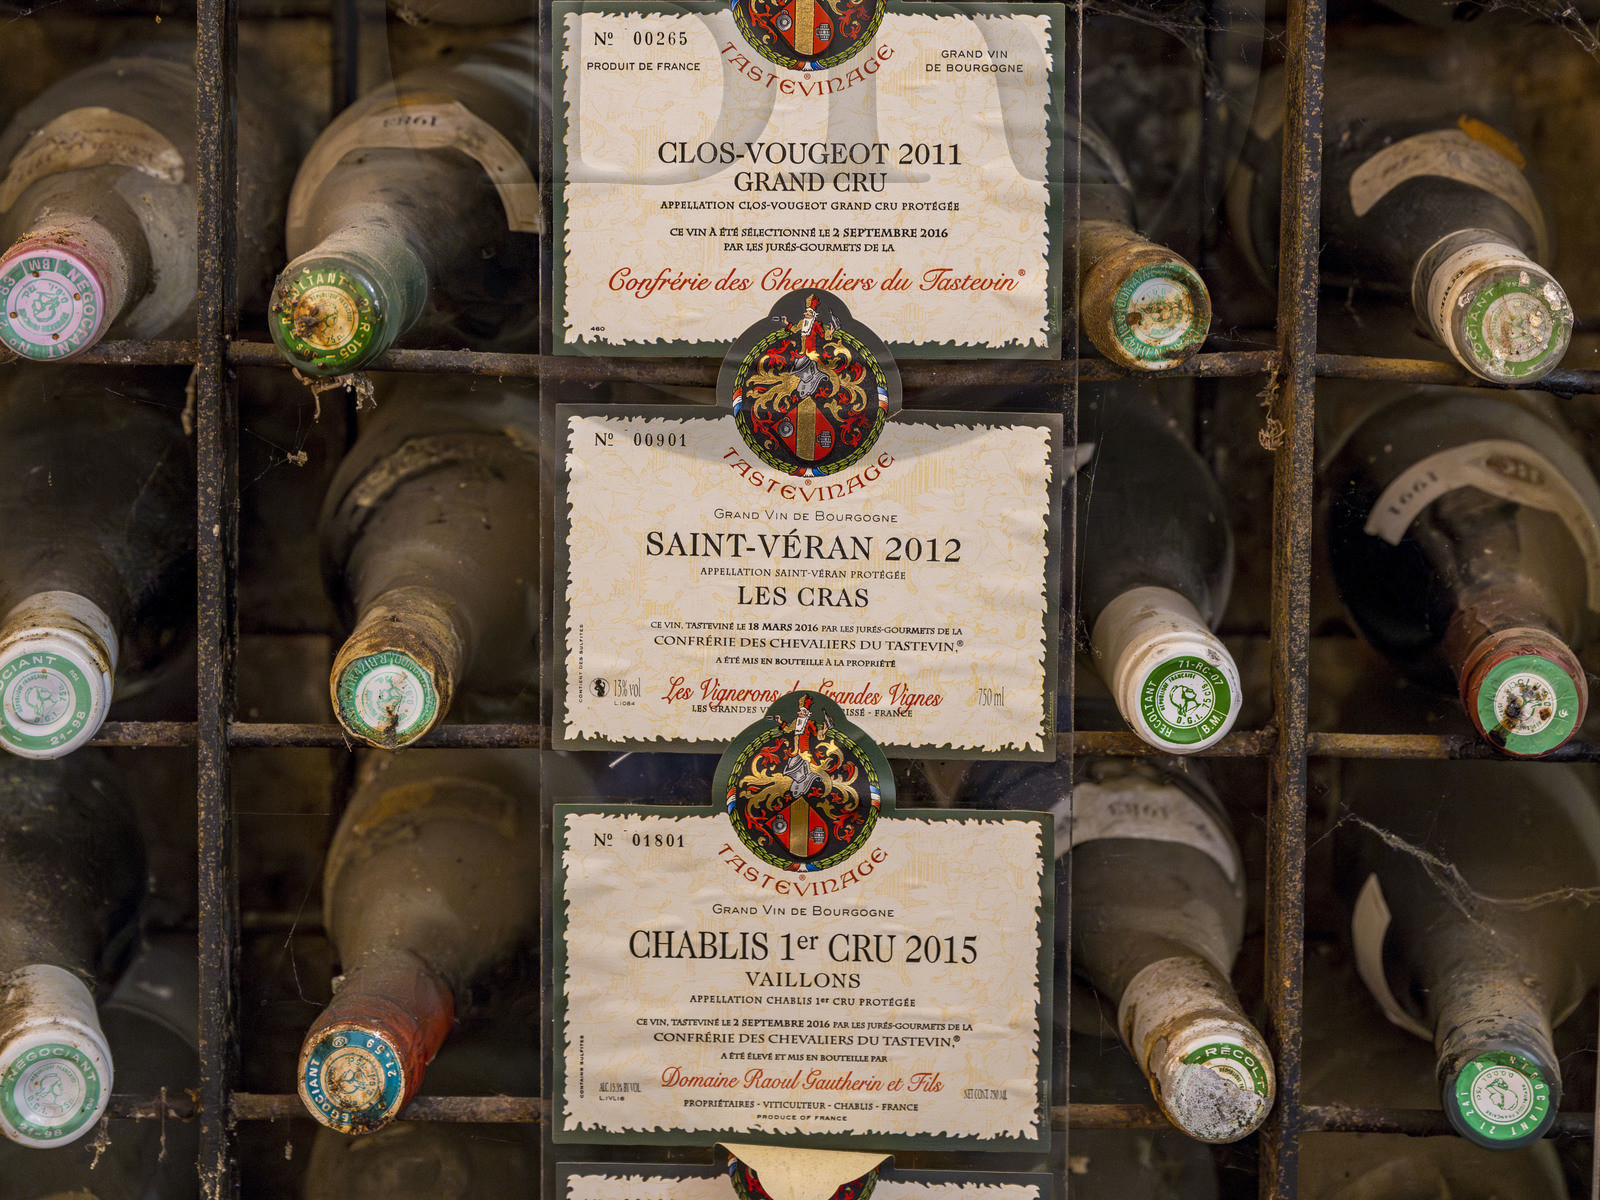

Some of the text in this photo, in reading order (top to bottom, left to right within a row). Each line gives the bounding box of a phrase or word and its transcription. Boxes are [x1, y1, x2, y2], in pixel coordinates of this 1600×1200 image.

[633, 30, 688, 46] 00265
[940, 49, 1008, 59] GRAND VIN
[586, 61, 701, 72] PRODUIT DE FRANCE
[723, 41, 896, 97] TASTEVINAGE
[925, 63, 1024, 73] DE BOURGOGNE
[657, 140, 962, 166] CLOS-VOUGEOT 2011
[733, 171, 888, 193] GRAND CRU
[659, 200, 960, 212] APPELLATION CLOS-VOUGEOT GRAND CRU PROTÉGÉE
[608, 267, 713, 300] Confrérie
[714, 267, 754, 292] des
[760, 266, 874, 292] Chevaliers
[880, 267, 914, 292] du
[633, 432, 686, 448] 00901
[723, 446, 896, 502] TASTEVINAGE
[646, 529, 962, 563] SAINT-VÉRAN 2012
[700, 567, 906, 580] APPELLATION SAINT-VÉRAN PROTÉGÉE
[737, 585, 869, 608] LES CRAS
[661, 676, 694, 704] Les
[631, 833, 685, 848] 01801
[717, 843, 889, 898] TASTEVINAGE
[628, 929, 978, 965] CHABLIS 1er CRU 2015
[744, 971, 861, 989] VAILLONS
[689, 994, 916, 1008] APPELLATION CHABLIS 1er CRU PROTÉGÉE
[660, 1065, 740, 1089] Domaine
[742, 1067, 804, 1090] Raoul
[802, 1067, 884, 1092] Gautherin
[886, 1076, 905, 1092] et
[907, 1071, 945, 1093] Fils
